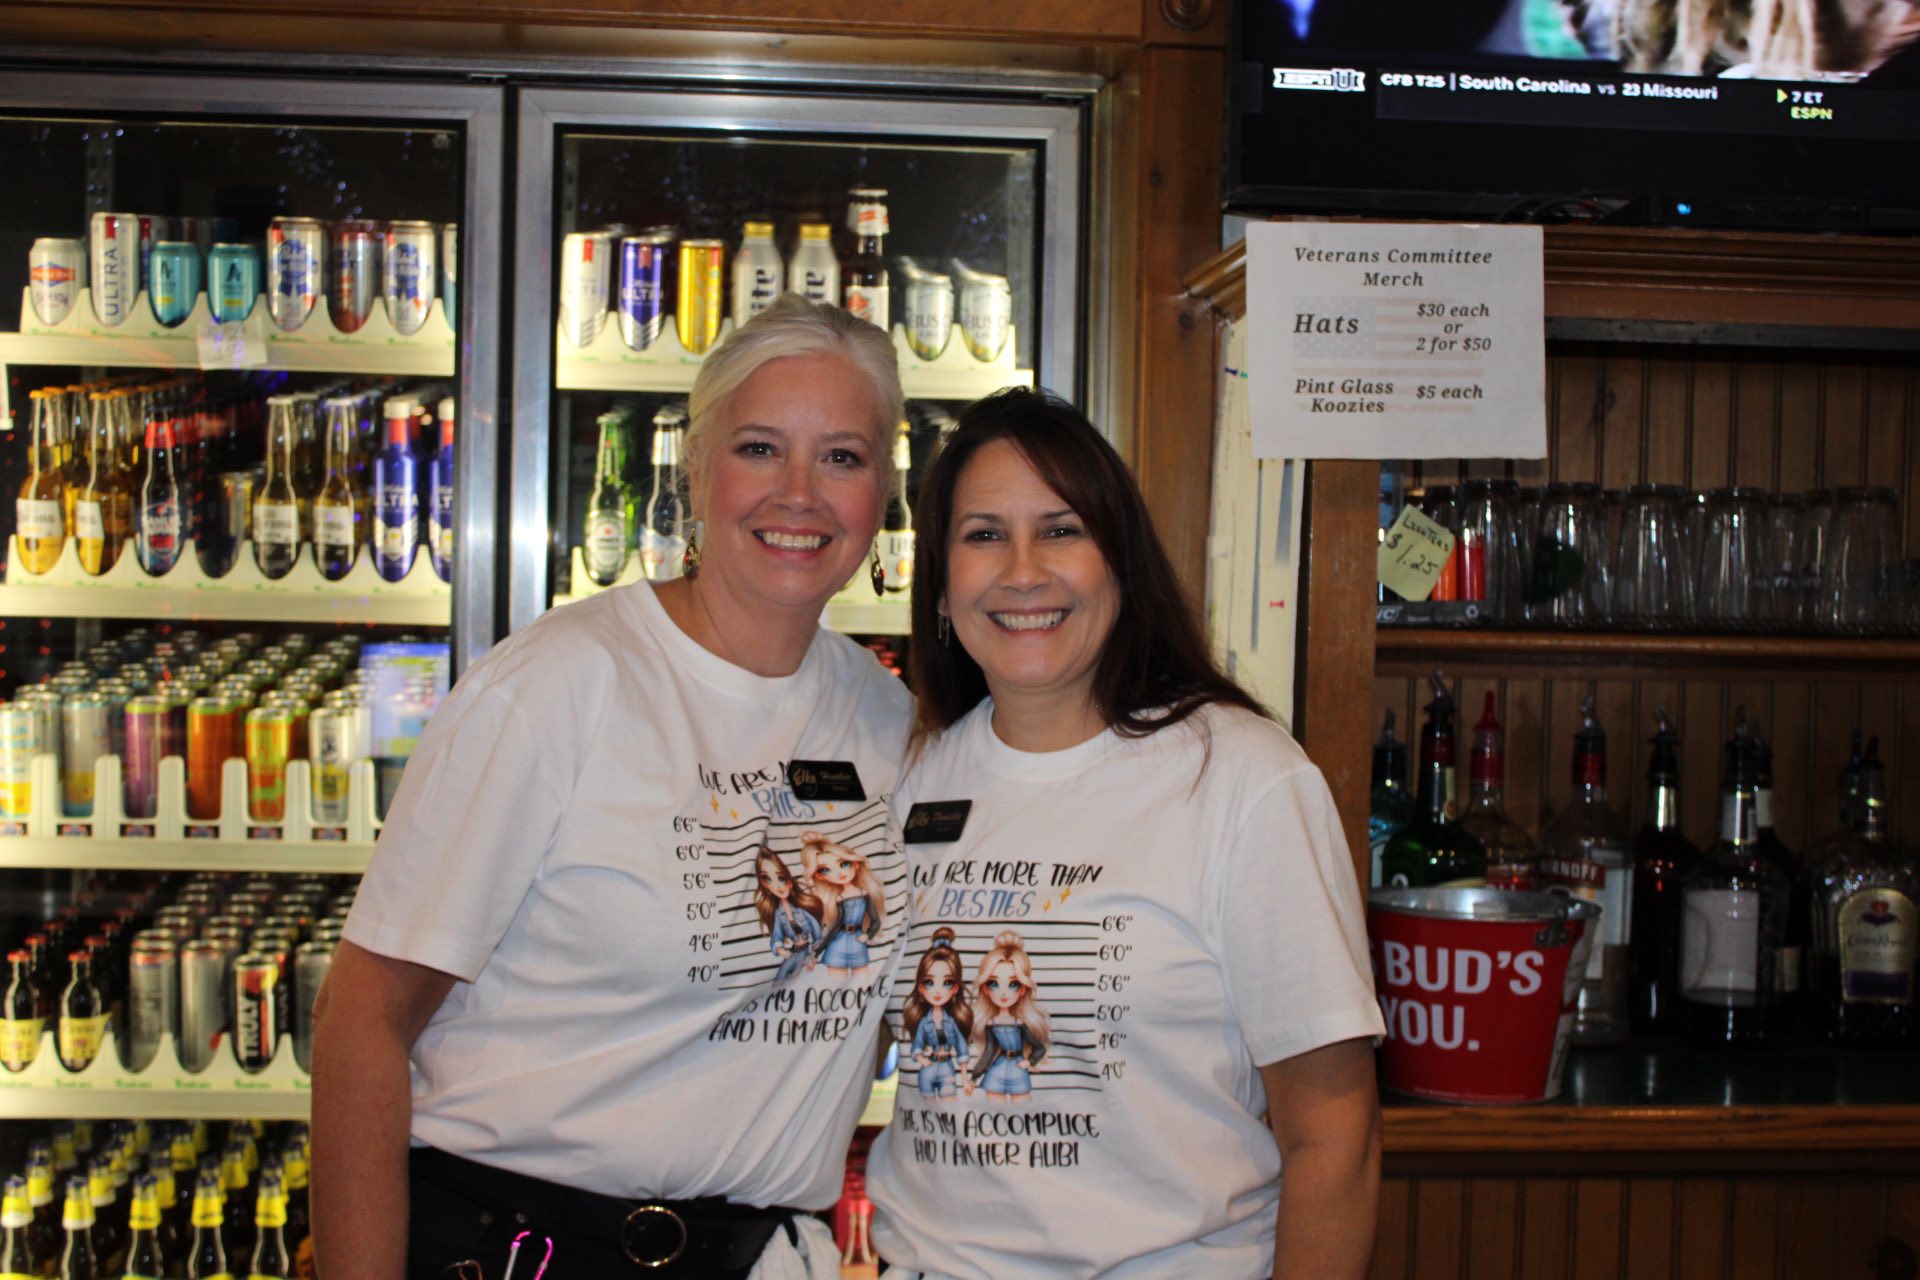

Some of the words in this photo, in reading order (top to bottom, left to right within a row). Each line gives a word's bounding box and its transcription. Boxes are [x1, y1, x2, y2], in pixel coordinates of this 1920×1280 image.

[1380, 73, 1413, 87] CFB
[1415, 74, 1446, 88] T25
[1459, 75, 1514, 91] South
[1516, 77, 1591, 96] Carolina
[1598, 84, 1616, 95] vs
[1622, 83, 1641, 97] 23
[1643, 83, 1718, 100] Missouri
[1792, 91, 1801, 103] 7
[1803, 91, 1824, 103] ET
[1791, 107, 1833, 120] ESPN
[1294, 247, 1380, 263] Veterans
[1387, 249, 1493, 265] Committee
[104, 247, 120, 317] ULTRA
[1362, 272, 1424, 287] Merch
[1417, 303, 1445, 318] $30
[1450, 303, 1490, 317] each
[1293, 313, 1359, 334] Hats
[1443, 323, 1463, 334] or
[1416, 338, 1426, 351] 2
[1428, 337, 1457, 355] for
[1462, 337, 1492, 352] $50
[1295, 379, 1335, 394] Pint
[1341, 379, 1394, 395] Glass
[1416, 385, 1436, 400] $5
[1441, 385, 1484, 399] each
[1311, 398, 1385, 413] Koozies
[698, 763, 727, 796] WE
[730, 767, 777, 796] ARE
[673, 815, 698, 833] 6'6"
[676, 844, 705, 862] 6'0"
[684, 873, 710, 890] 5'6"
[943, 860, 977, 885] ARE
[982, 860, 1042, 886] MORE
[1051, 863, 1104, 887] THAN
[687, 902, 717, 921] 5'0"
[937, 888, 1037, 918] BESTIES
[1102, 915, 1133, 932] 6'6"
[689, 933, 719, 953] 4'6"
[1099, 944, 1133, 961] 6'0"
[687, 965, 720, 984] 4'0"
[1384, 940, 1545, 996] BUD'S
[1098, 975, 1131, 992] 5'6"
[764, 989, 796, 1013] MY
[1096, 1005, 1130, 1021] 5'0"
[241, 998, 259, 1057] TRULY
[709, 1018, 755, 1043] AND
[762, 1020, 768, 1042] I
[777, 1017, 807, 1044] AM
[810, 1017, 849, 1042] HER
[1378, 993, 1481, 1052] YOU.
[1099, 1033, 1127, 1050] 4'6"
[1102, 1062, 1127, 1081] 4'0"
[921, 1110, 935, 1134] IS
[964, 1110, 1100, 1138] ACCOMPLICE
[978, 1142, 1021, 1166] HER
[1030, 1142, 1080, 1168] ALIBI
